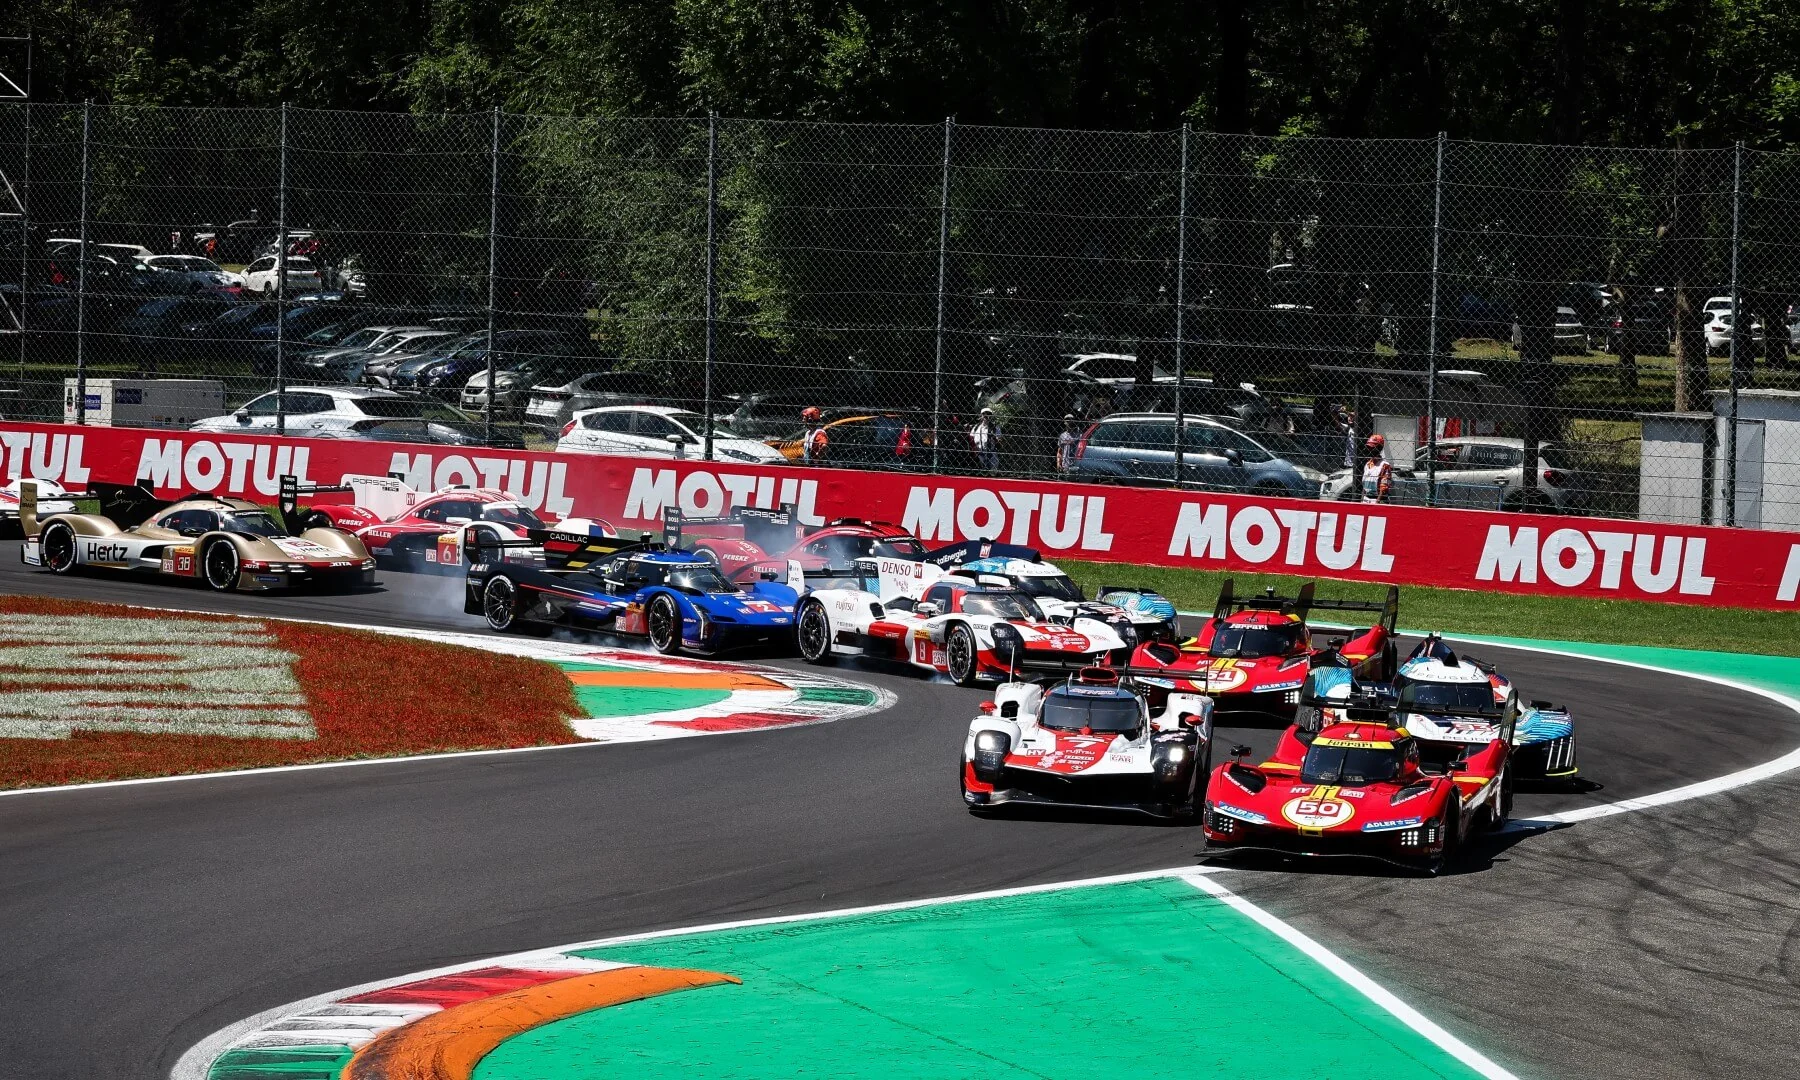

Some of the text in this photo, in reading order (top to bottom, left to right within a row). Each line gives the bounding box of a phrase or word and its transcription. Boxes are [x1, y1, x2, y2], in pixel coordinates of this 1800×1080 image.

[0, 431, 91, 483] TUL
[134, 438, 316, 497] MOTUL
[353, 478, 399, 487] PORSCHE
[387, 452, 575, 514] MOTUL
[406, 493, 415, 505] HY
[623, 466, 826, 527] MOTUL
[741, 509, 789, 519] PORSCHE
[901, 486, 1114, 551] MOTUL
[467, 530, 476, 542] HY
[550, 532, 588, 543] CADILLAC
[1167, 502, 1395, 573] MOTUL
[87, 542, 128, 561] Hertz
[443, 545, 452, 562] 6
[935, 549, 967, 565] talEnergies
[178, 556, 191, 571] 38
[1475, 524, 1716, 595] MOTUL
[882, 562, 911, 576] DENSO
[757, 603, 775, 612] 2
[836, 600, 854, 611] FUJITSU
[632, 613, 640, 631] 2
[920, 641, 926, 660] 8
[933, 656, 945, 664] CAR
[1208, 671, 1233, 680] 51
[1327, 740, 1373, 748] Ferrari
[1299, 801, 1339, 815] 50
[1367, 820, 1396, 829] ADLER
